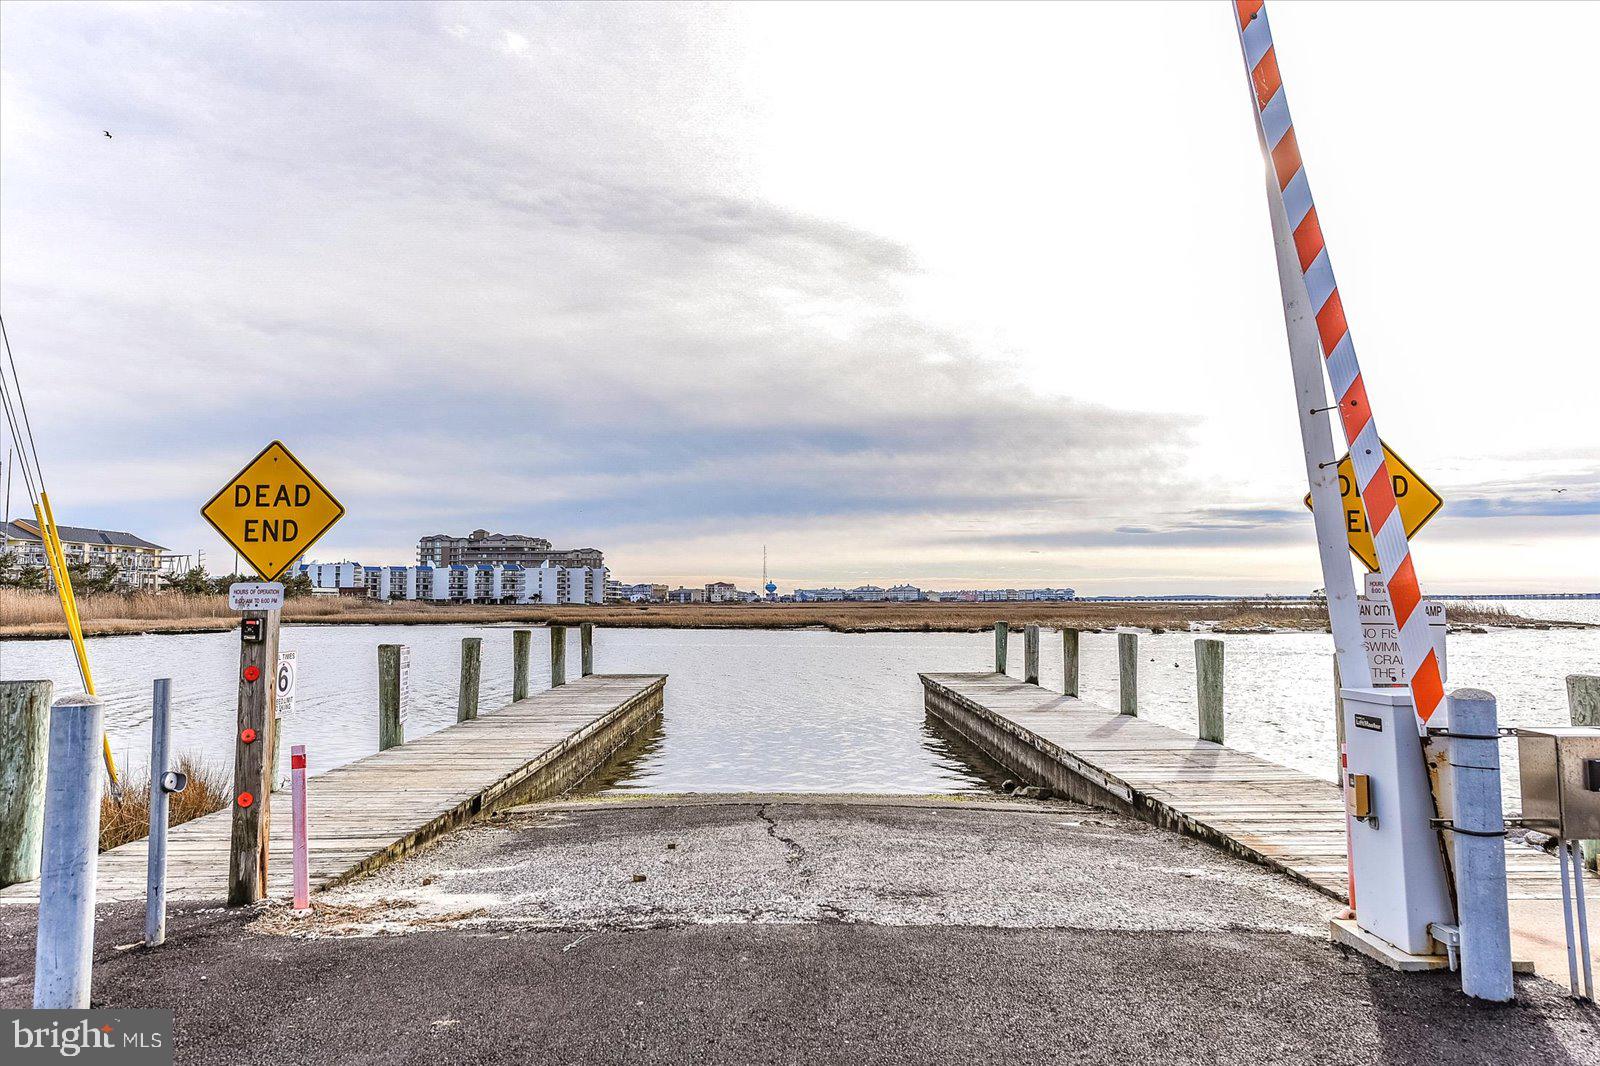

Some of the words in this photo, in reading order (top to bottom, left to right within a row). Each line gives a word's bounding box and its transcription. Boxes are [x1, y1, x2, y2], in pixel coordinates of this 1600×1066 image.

[1338, 474, 1409, 498] DD
[234, 484, 311, 508] DEAD
[243, 519, 299, 543] END
[1373, 604, 1391, 617] CITY
[282, 653, 296, 661] TIMES
[1373, 654, 1404, 665] CRA
[278, 665, 289, 693] 6
[1371, 667, 1395, 678] THE
